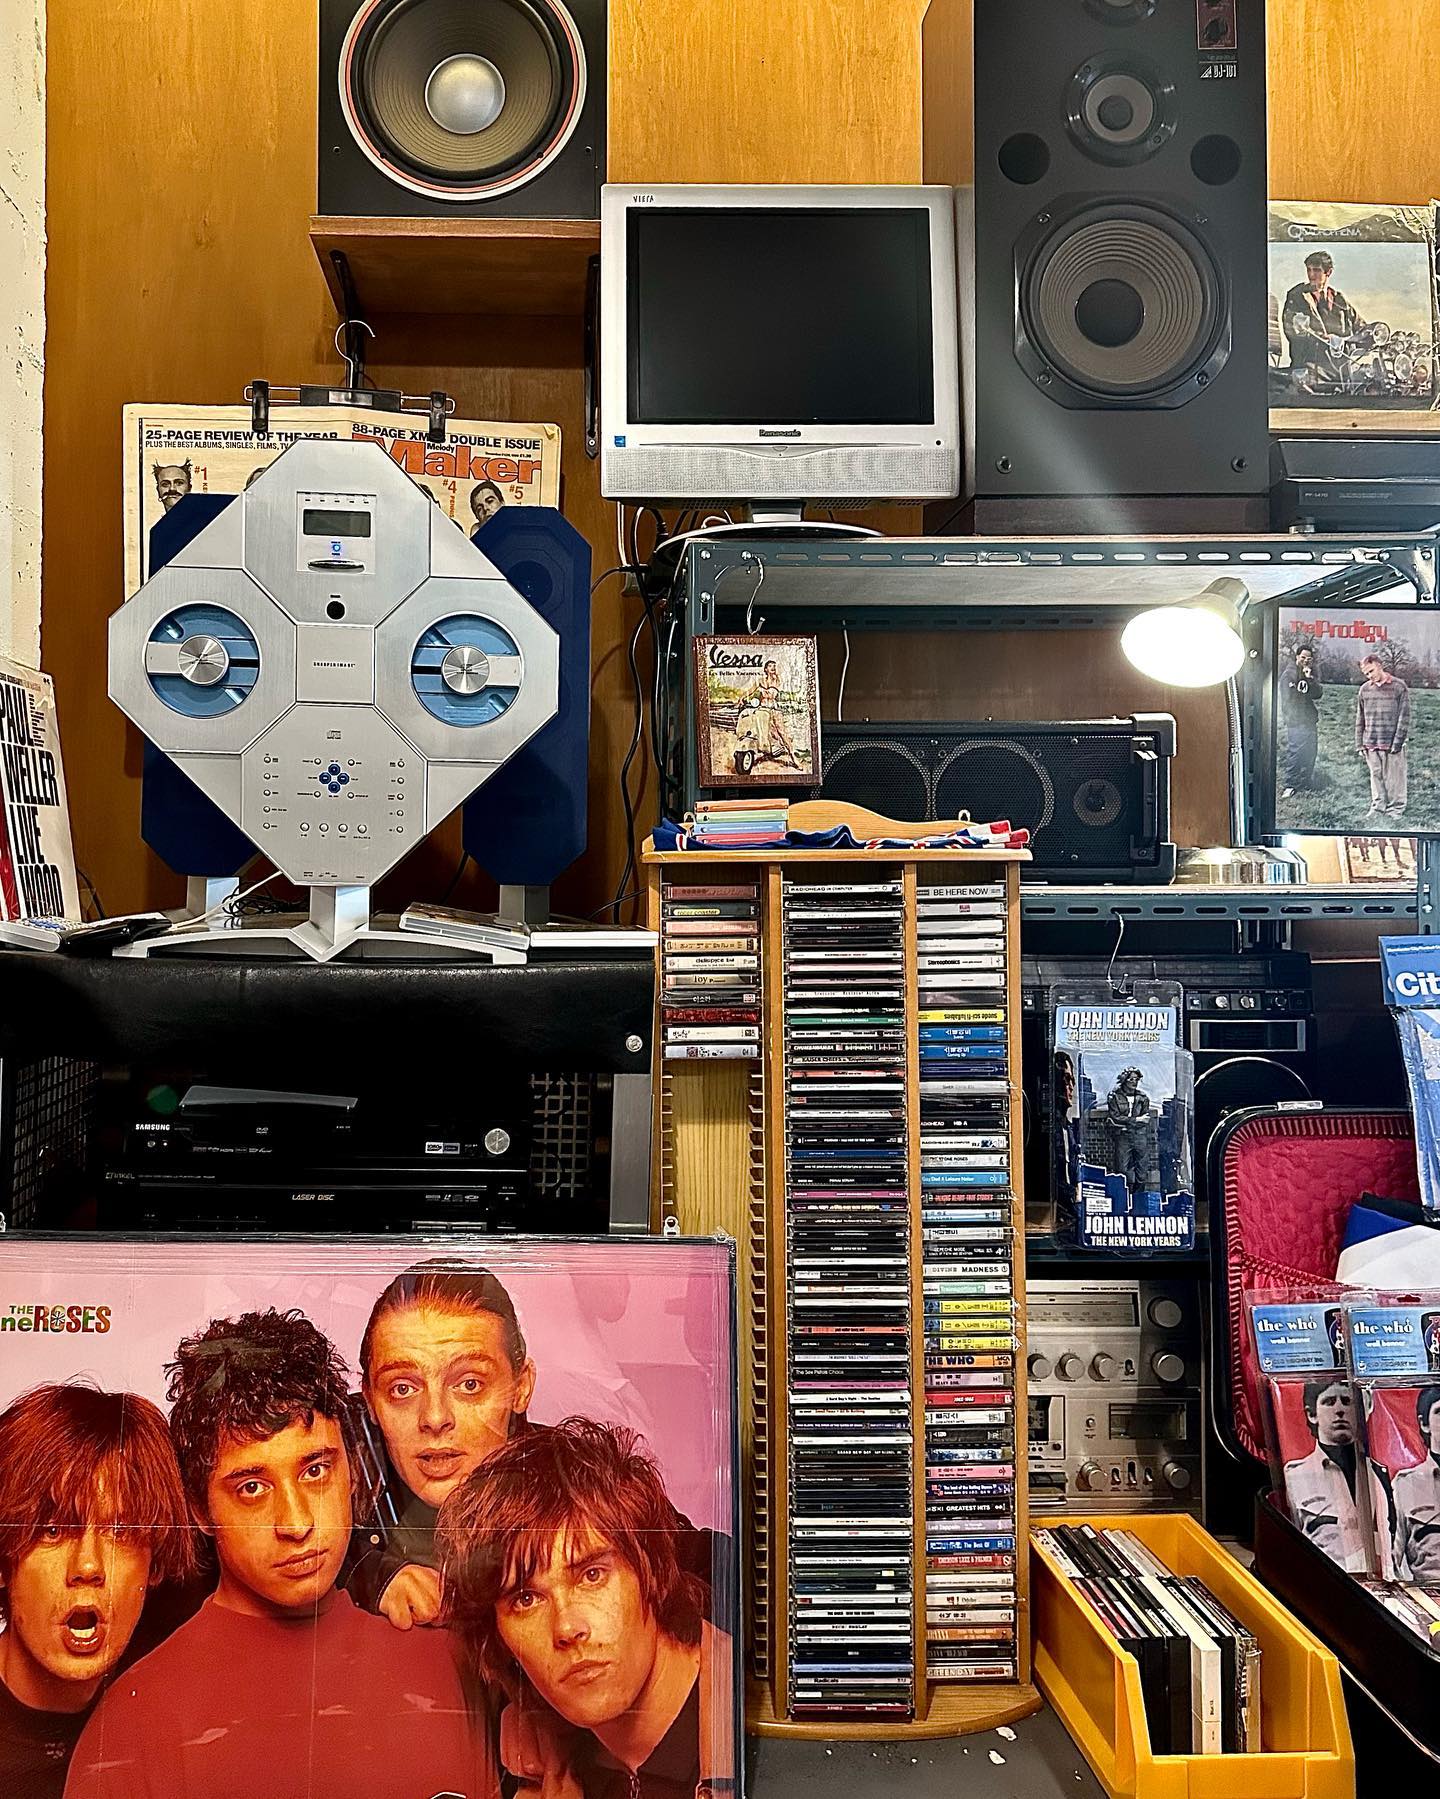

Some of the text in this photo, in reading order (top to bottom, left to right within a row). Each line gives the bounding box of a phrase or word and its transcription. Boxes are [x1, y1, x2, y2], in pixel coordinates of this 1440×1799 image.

[145, 430, 202, 440] 25-PAGE
[204, 431, 254, 441] REVIEW
[256, 432, 274, 441] OF
[278, 432, 300, 442] THE
[352, 423, 406, 440] 88-PAGE
[450, 434, 501, 449] DOUBLE
[504, 438, 541, 451] ISSUE
[759, 429, 801, 437] Panasonic
[194, 441, 224, 449] ALBUMS,
[225, 442, 255, 450] SINGLES,
[426, 442, 455, 454] Melody
[442, 478, 458, 494] #4
[509, 485, 524, 500] #5
[708, 644, 763, 669] Vespa
[3, 742, 60, 807] WELLER
[9, 804, 45, 865] LIVE
[18, 864, 64, 917] WOOD
[933, 888, 988, 896] BE HERE NOW
[1061, 1011, 1169, 1031] JOHN LENNON
[1067, 1031, 1161, 1043] THE NEW YORK YEARS
[135, 1123, 171, 1131] SAMSUNG
[1084, 1216, 1189, 1235] JOHN LENNON
[1090, 1236, 1181, 1247] THE NEW YORK YEARS
[9, 1305, 34, 1314] THE
[33, 1305, 112, 1333] ROSES
[1257, 1314, 1317, 1333] the who
[1353, 1318, 1414, 1335] the who
[1270, 1337, 1286, 1345] wall
[946, 1356, 975, 1365] WHO
[927, 1667, 976, 1677] GREEN DAY
